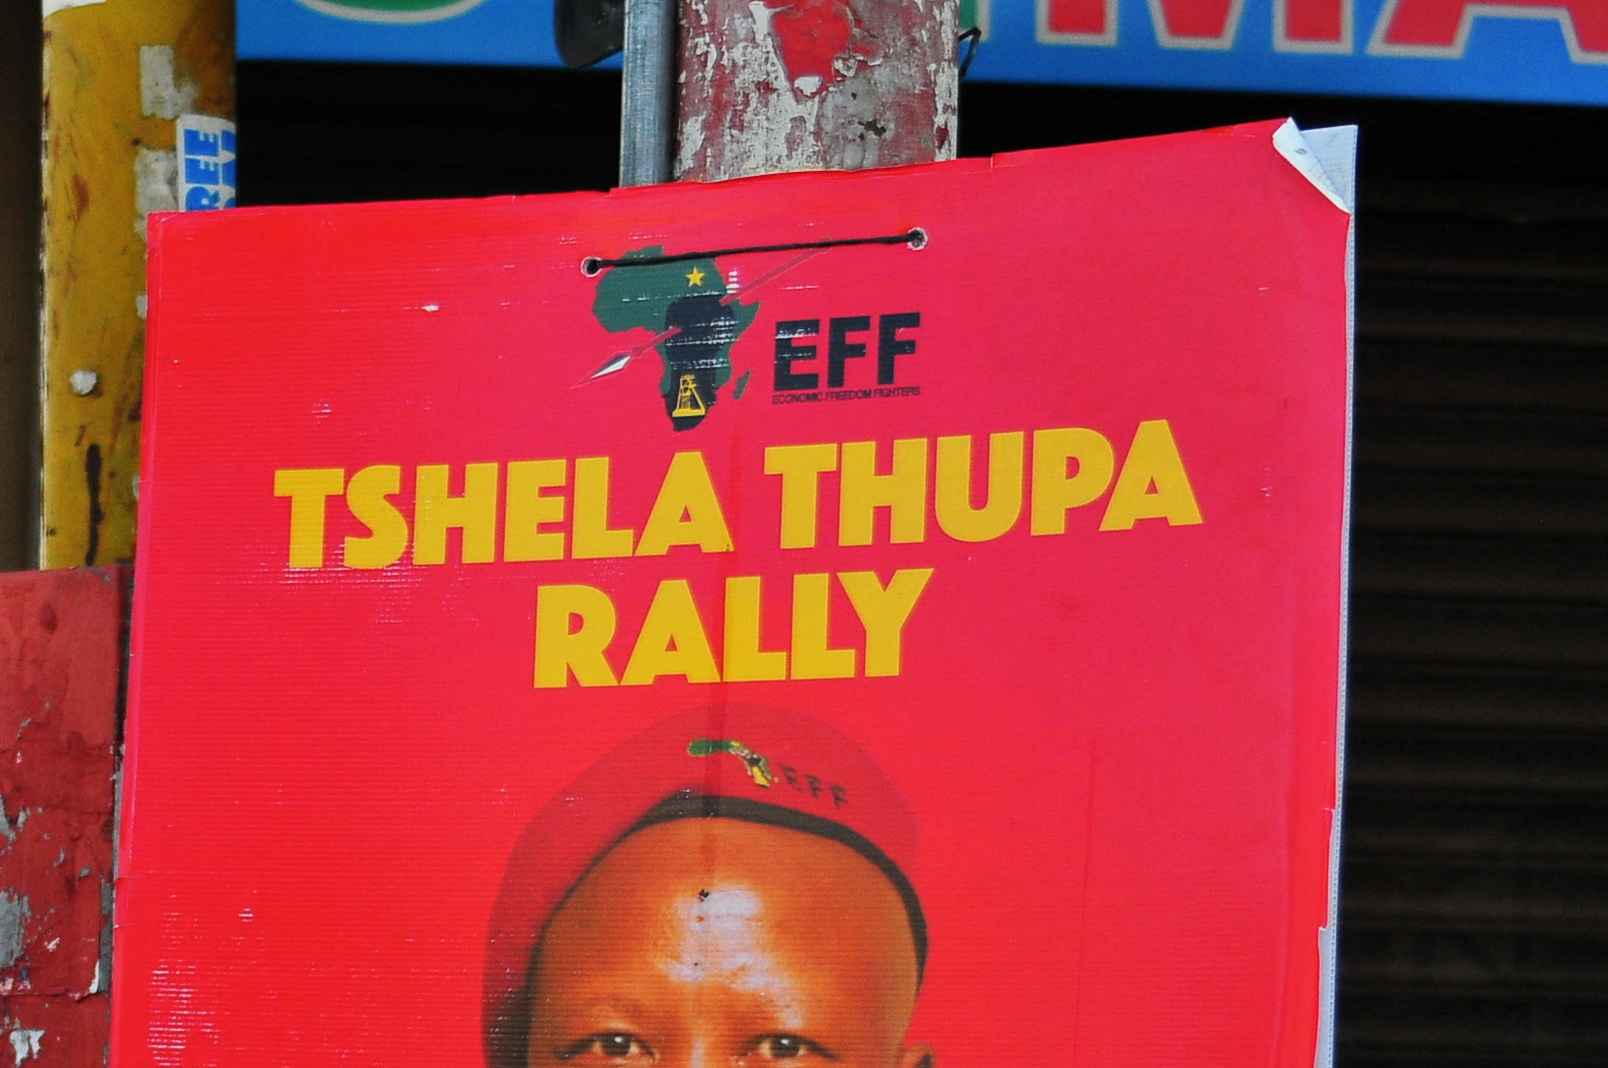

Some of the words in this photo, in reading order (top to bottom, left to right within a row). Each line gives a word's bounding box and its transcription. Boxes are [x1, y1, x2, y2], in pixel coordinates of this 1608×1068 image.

[771, 391, 823, 405] ECONOMIC
[825, 388, 872, 401] FREEDOM
[873, 385, 921, 398] FIGHTERS
[774, 312, 921, 392] EFF
[273, 451, 734, 570] TSHELA
[764, 419, 1204, 549] THUPA
[534, 568, 934, 689] RALLY
